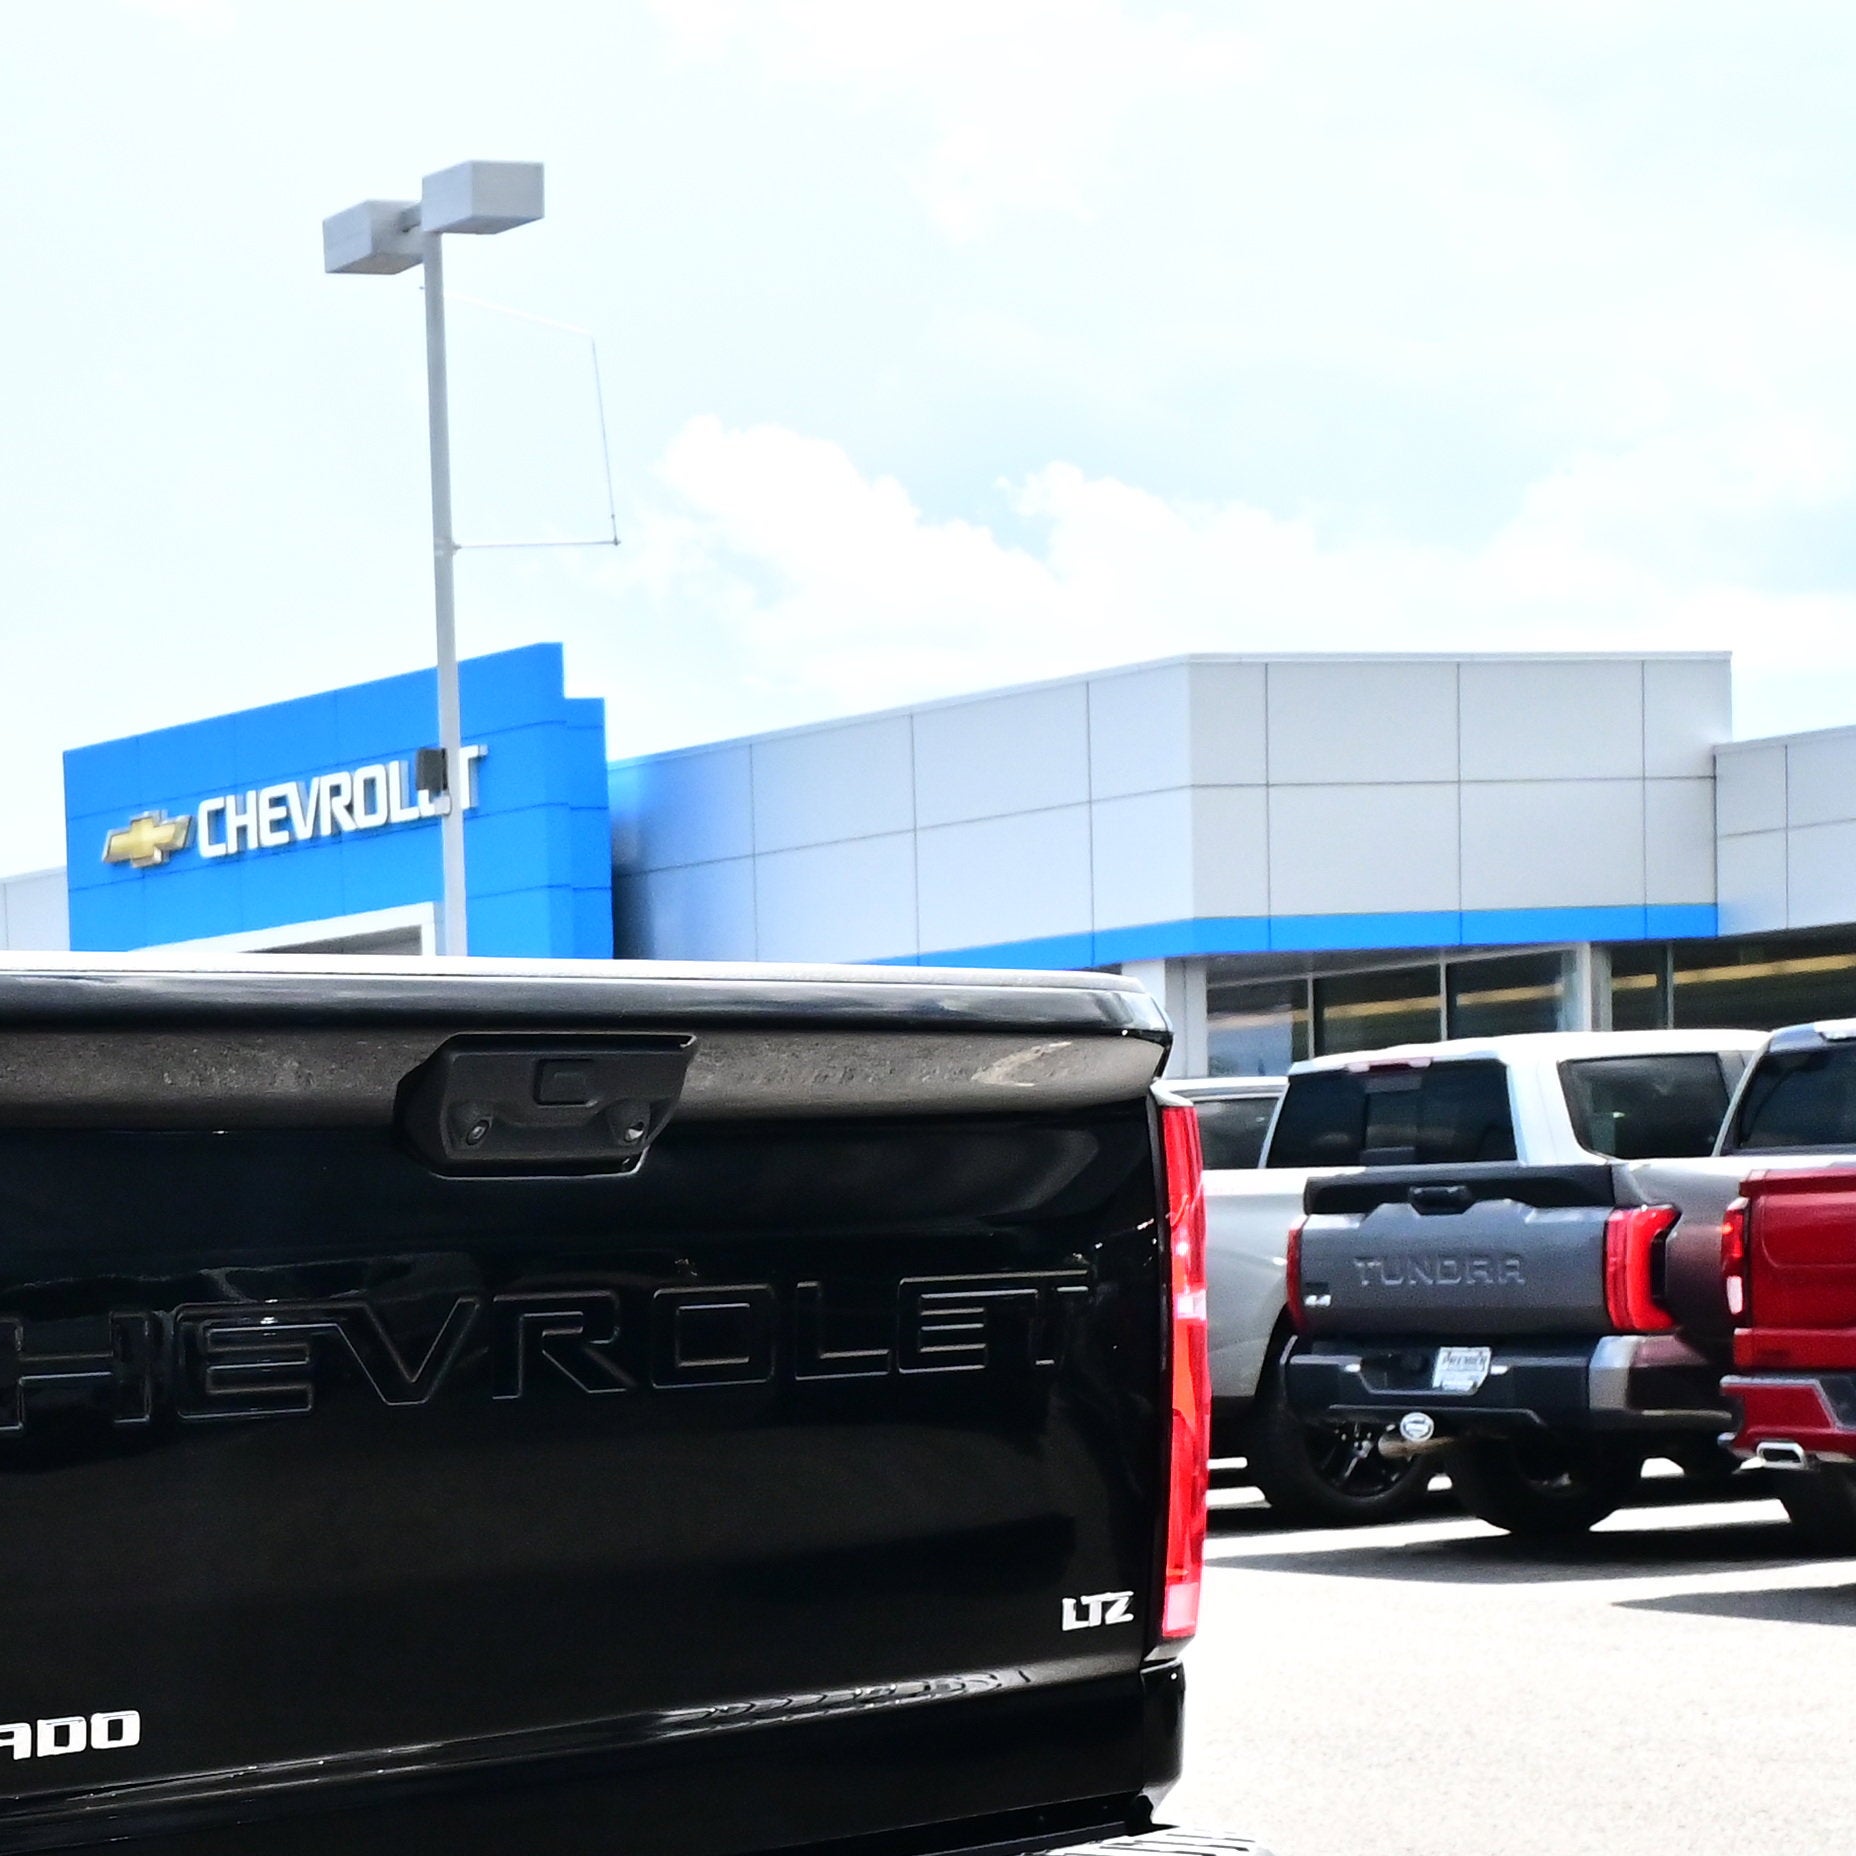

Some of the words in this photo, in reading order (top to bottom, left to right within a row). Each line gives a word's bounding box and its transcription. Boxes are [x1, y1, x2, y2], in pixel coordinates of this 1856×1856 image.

[197, 745, 484, 858] CHEVROLT
[1353, 1253, 1526, 1286] TUNDRA
[1061, 1590, 1135, 1631] LTZ
